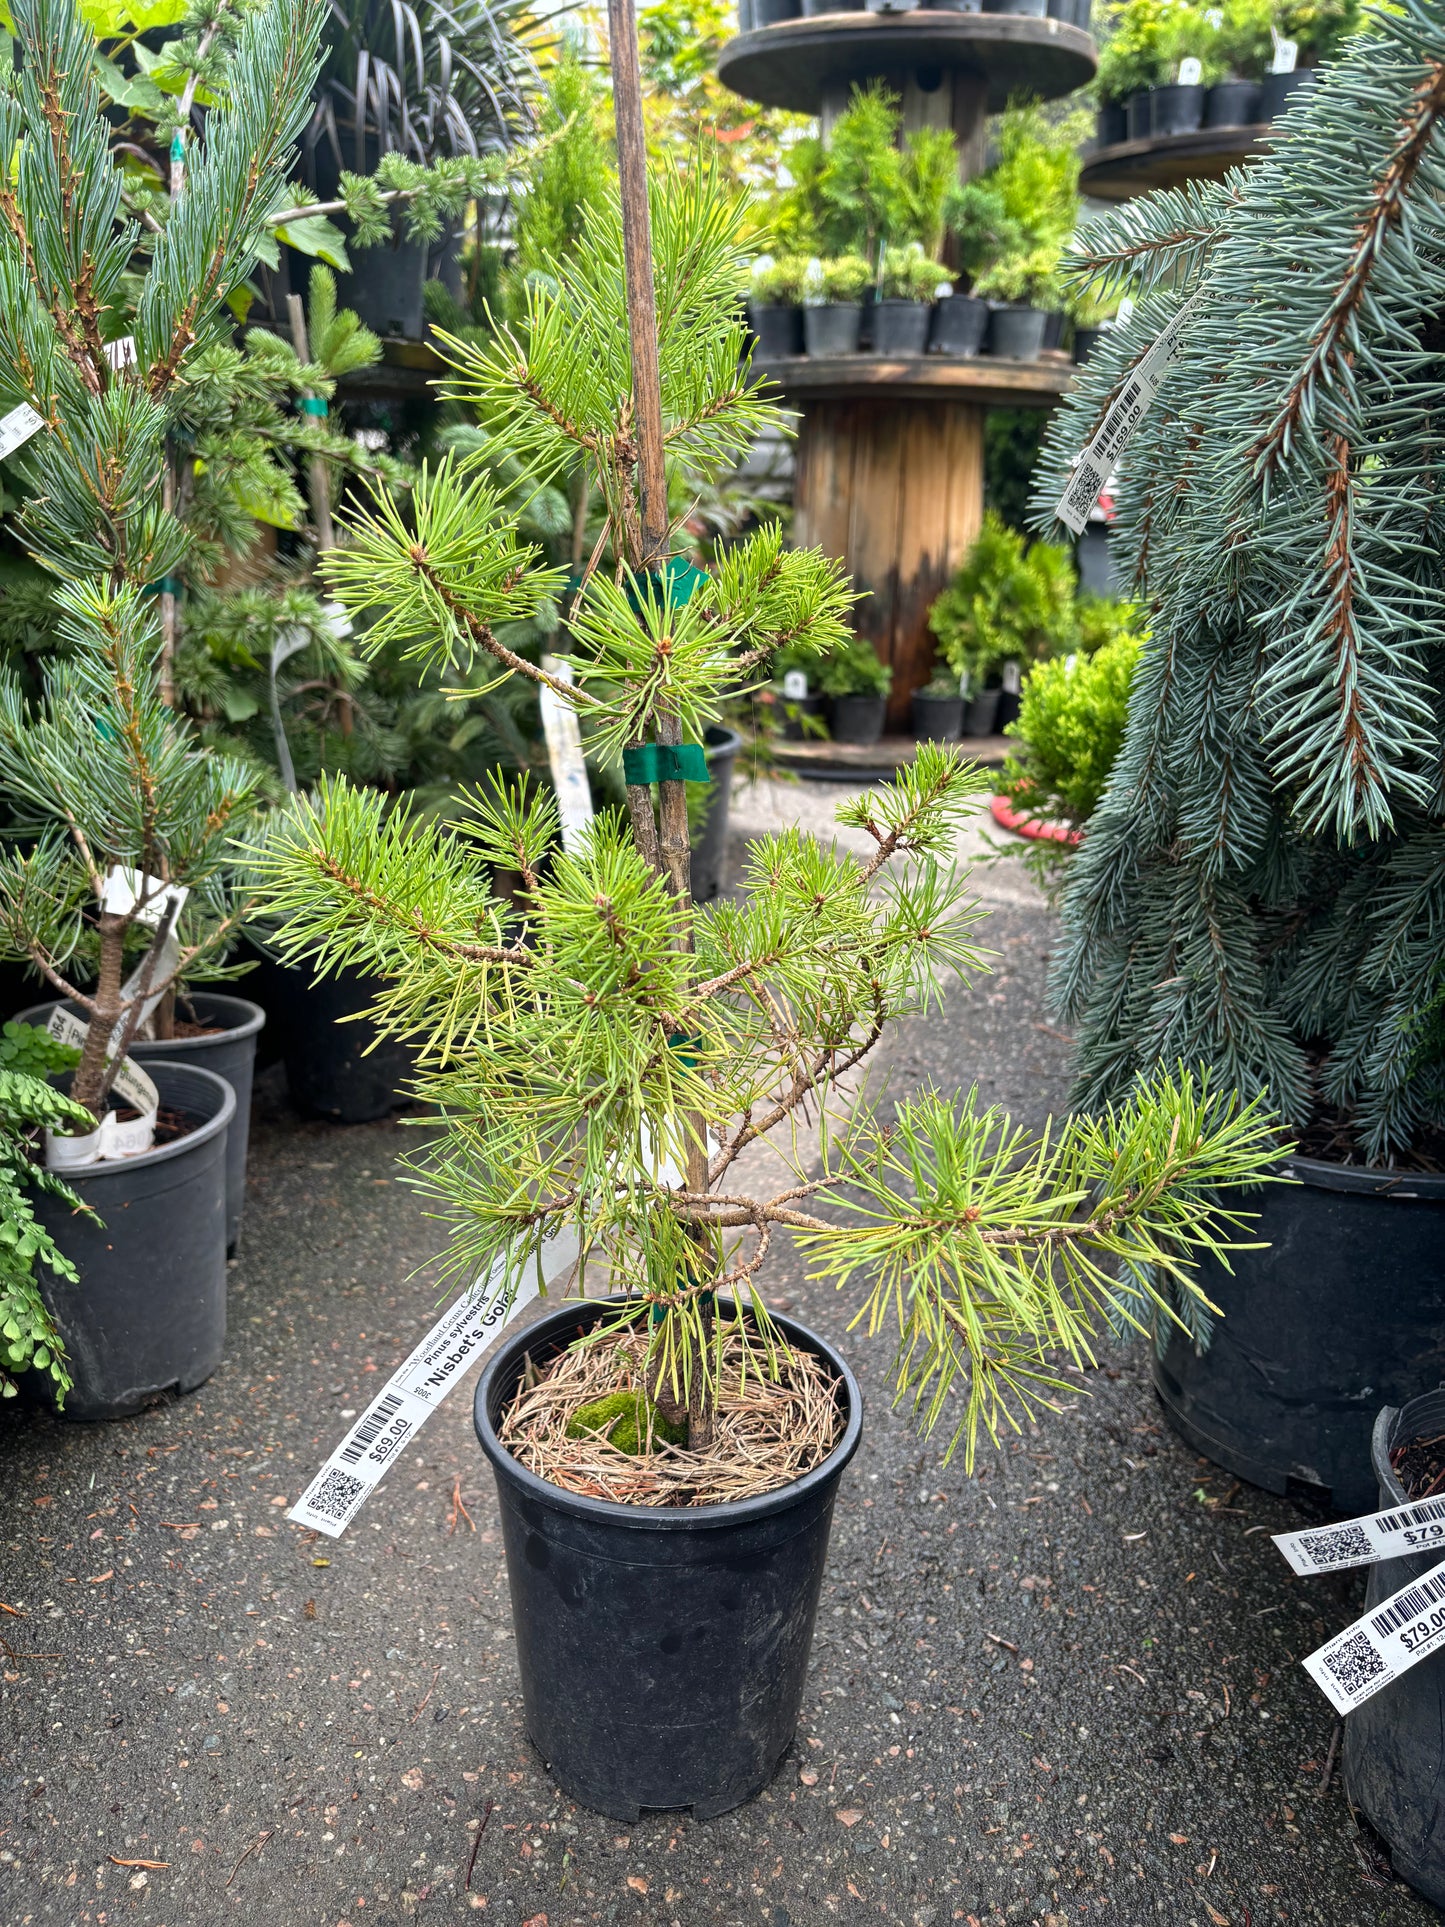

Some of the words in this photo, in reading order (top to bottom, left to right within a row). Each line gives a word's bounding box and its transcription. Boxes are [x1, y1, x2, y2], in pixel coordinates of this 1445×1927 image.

[1105, 404, 1141, 461] $169.00
[423, 1338, 450, 1365] Pinus
[449, 1294, 489, 1339] sylvestris
[442, 1308, 462, 1329] Gems
[423, 1327, 484, 1386] 'Nisbet's
[413, 1386, 430, 1398] 3005
[368, 1417, 407, 1462] $69.00
[1416, 1647, 1427, 1656] Pot
